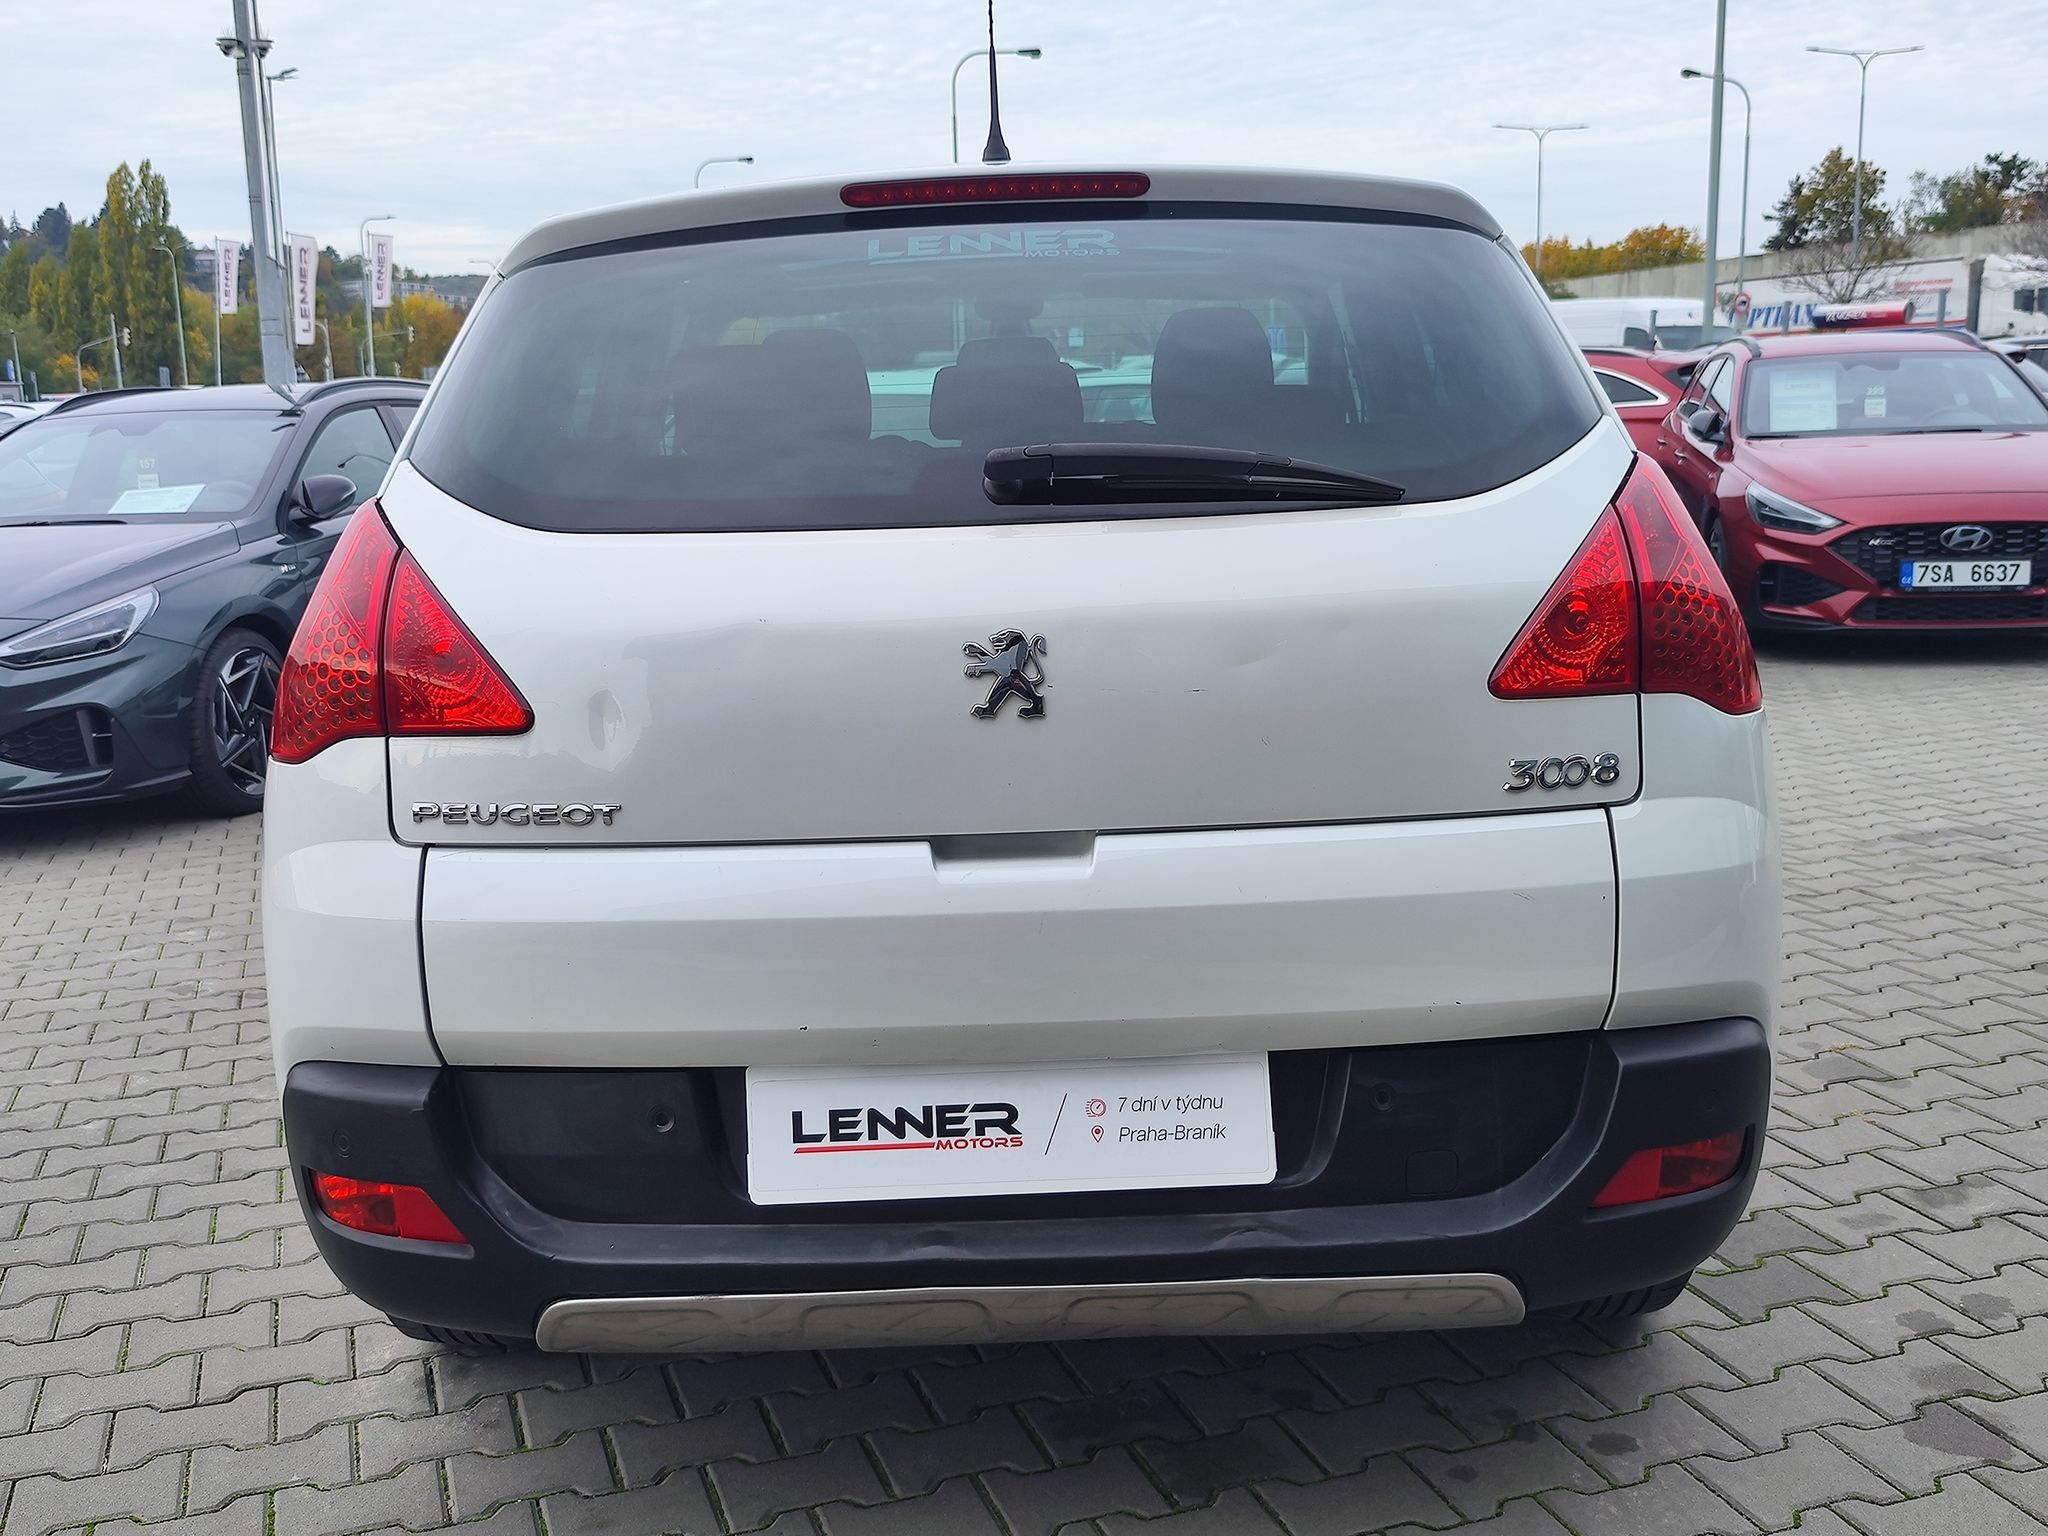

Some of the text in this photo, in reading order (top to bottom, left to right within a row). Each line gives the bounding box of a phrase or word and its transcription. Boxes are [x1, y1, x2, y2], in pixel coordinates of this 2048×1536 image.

[867, 229, 1121, 259] LENNER
[1024, 249, 1121, 258] MOTORS
[377, 242, 387, 300] LENNER
[300, 247, 312, 334] LENNER
[1918, 563, 2021, 583] 7SA 6637
[1502, 751, 1620, 791] 3008
[411, 801, 622, 827] PEUGEOT
[1118, 1094, 1224, 1114] 7 dní v týdnu
[791, 1102, 1023, 1144] LENNER
[1119, 1123, 1227, 1142] Praha-Braník
[935, 1136, 1024, 1151] MOTORS
